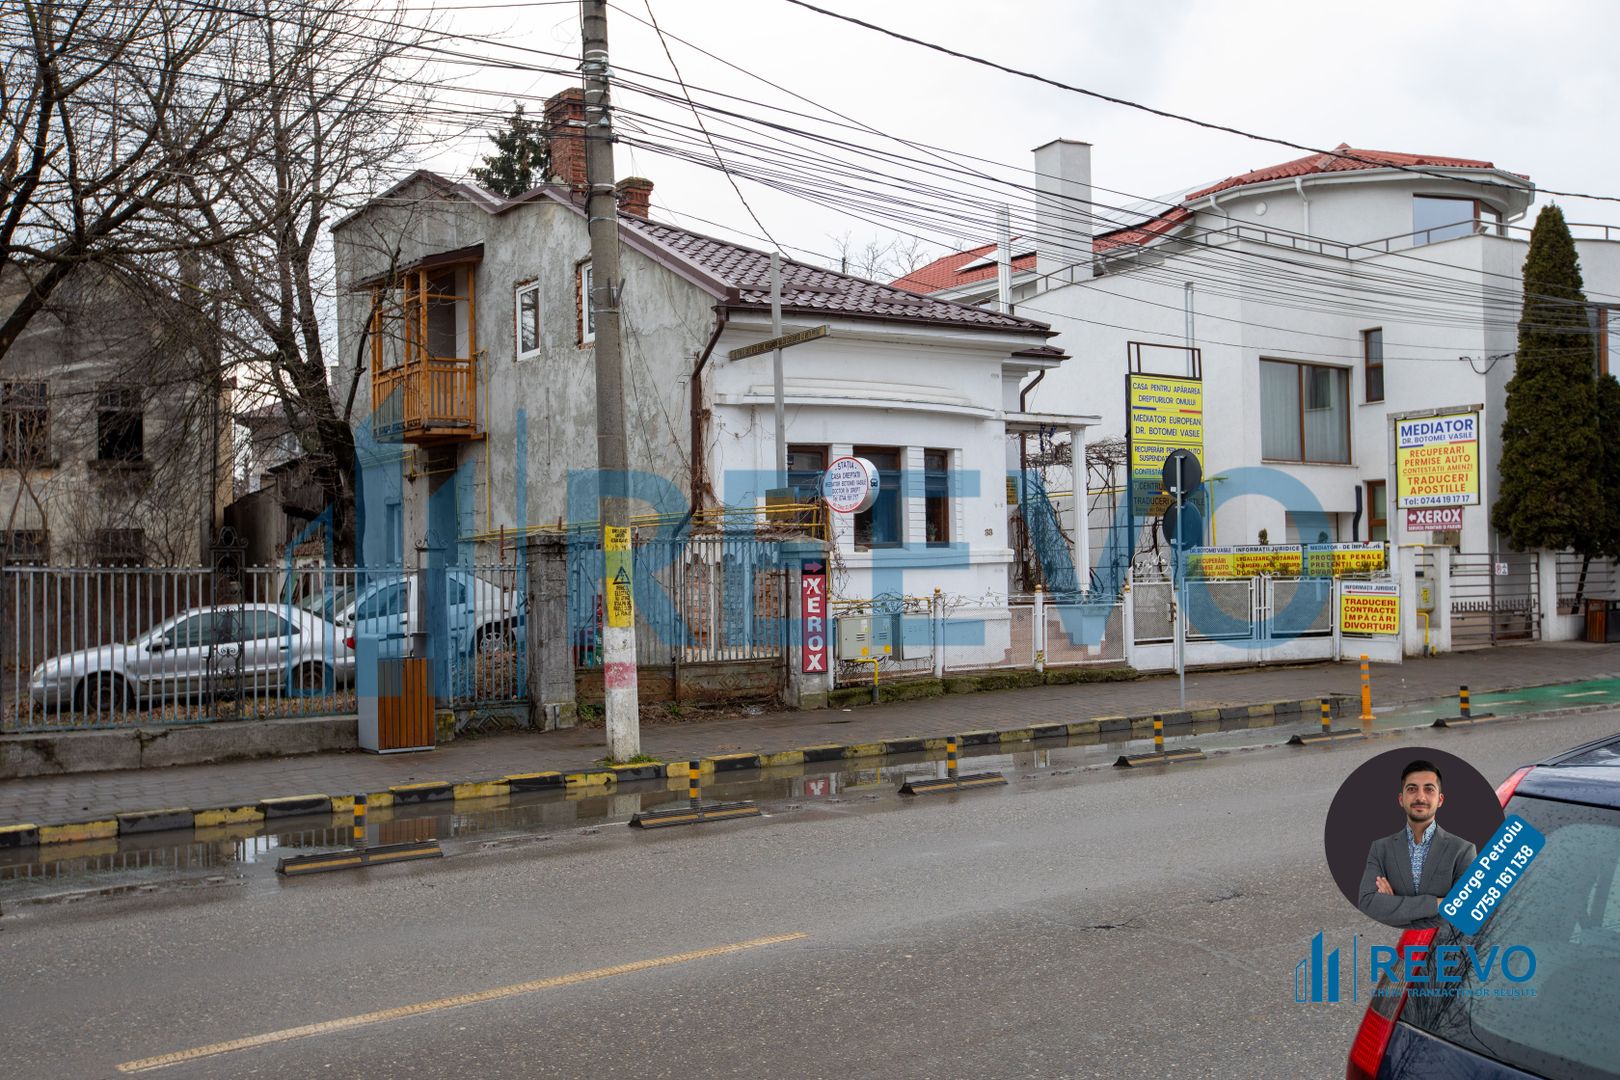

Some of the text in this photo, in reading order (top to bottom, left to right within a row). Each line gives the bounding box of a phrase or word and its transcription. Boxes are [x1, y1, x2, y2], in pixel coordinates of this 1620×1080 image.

[1132, 382, 1148, 390] CASA
[1150, 384, 1172, 392] PENTRU
[1134, 414, 1202, 426] MEDIATOR EUROPEAN
[1136, 426, 1200, 438] DR. BOTOMEI VASILE
[1401, 418, 1474, 438] MEDIATOR
[1414, 434, 1446, 444] BOTOMEI
[1448, 432, 1472, 440] VASILE
[1410, 446, 1464, 458] RECUPERARI
[1405, 454, 1471, 467] PERMISE AUTO
[1408, 473, 1468, 486] TRADUCERI
[1410, 484, 1466, 496] APOSTILLE
[1404, 498, 1419, 506] Tel:
[1420, 496, 1441, 504] 0744
[1453, 495, 1460, 503] 17
[1416, 508, 1461, 524] XEROX
[1345, 598, 1396, 606] TRADUCERI
[1344, 606, 1396, 614] CONTRACTE
[807, 577, 824, 671] XEROX
[1344, 622, 1396, 632] DIVORȚURI
